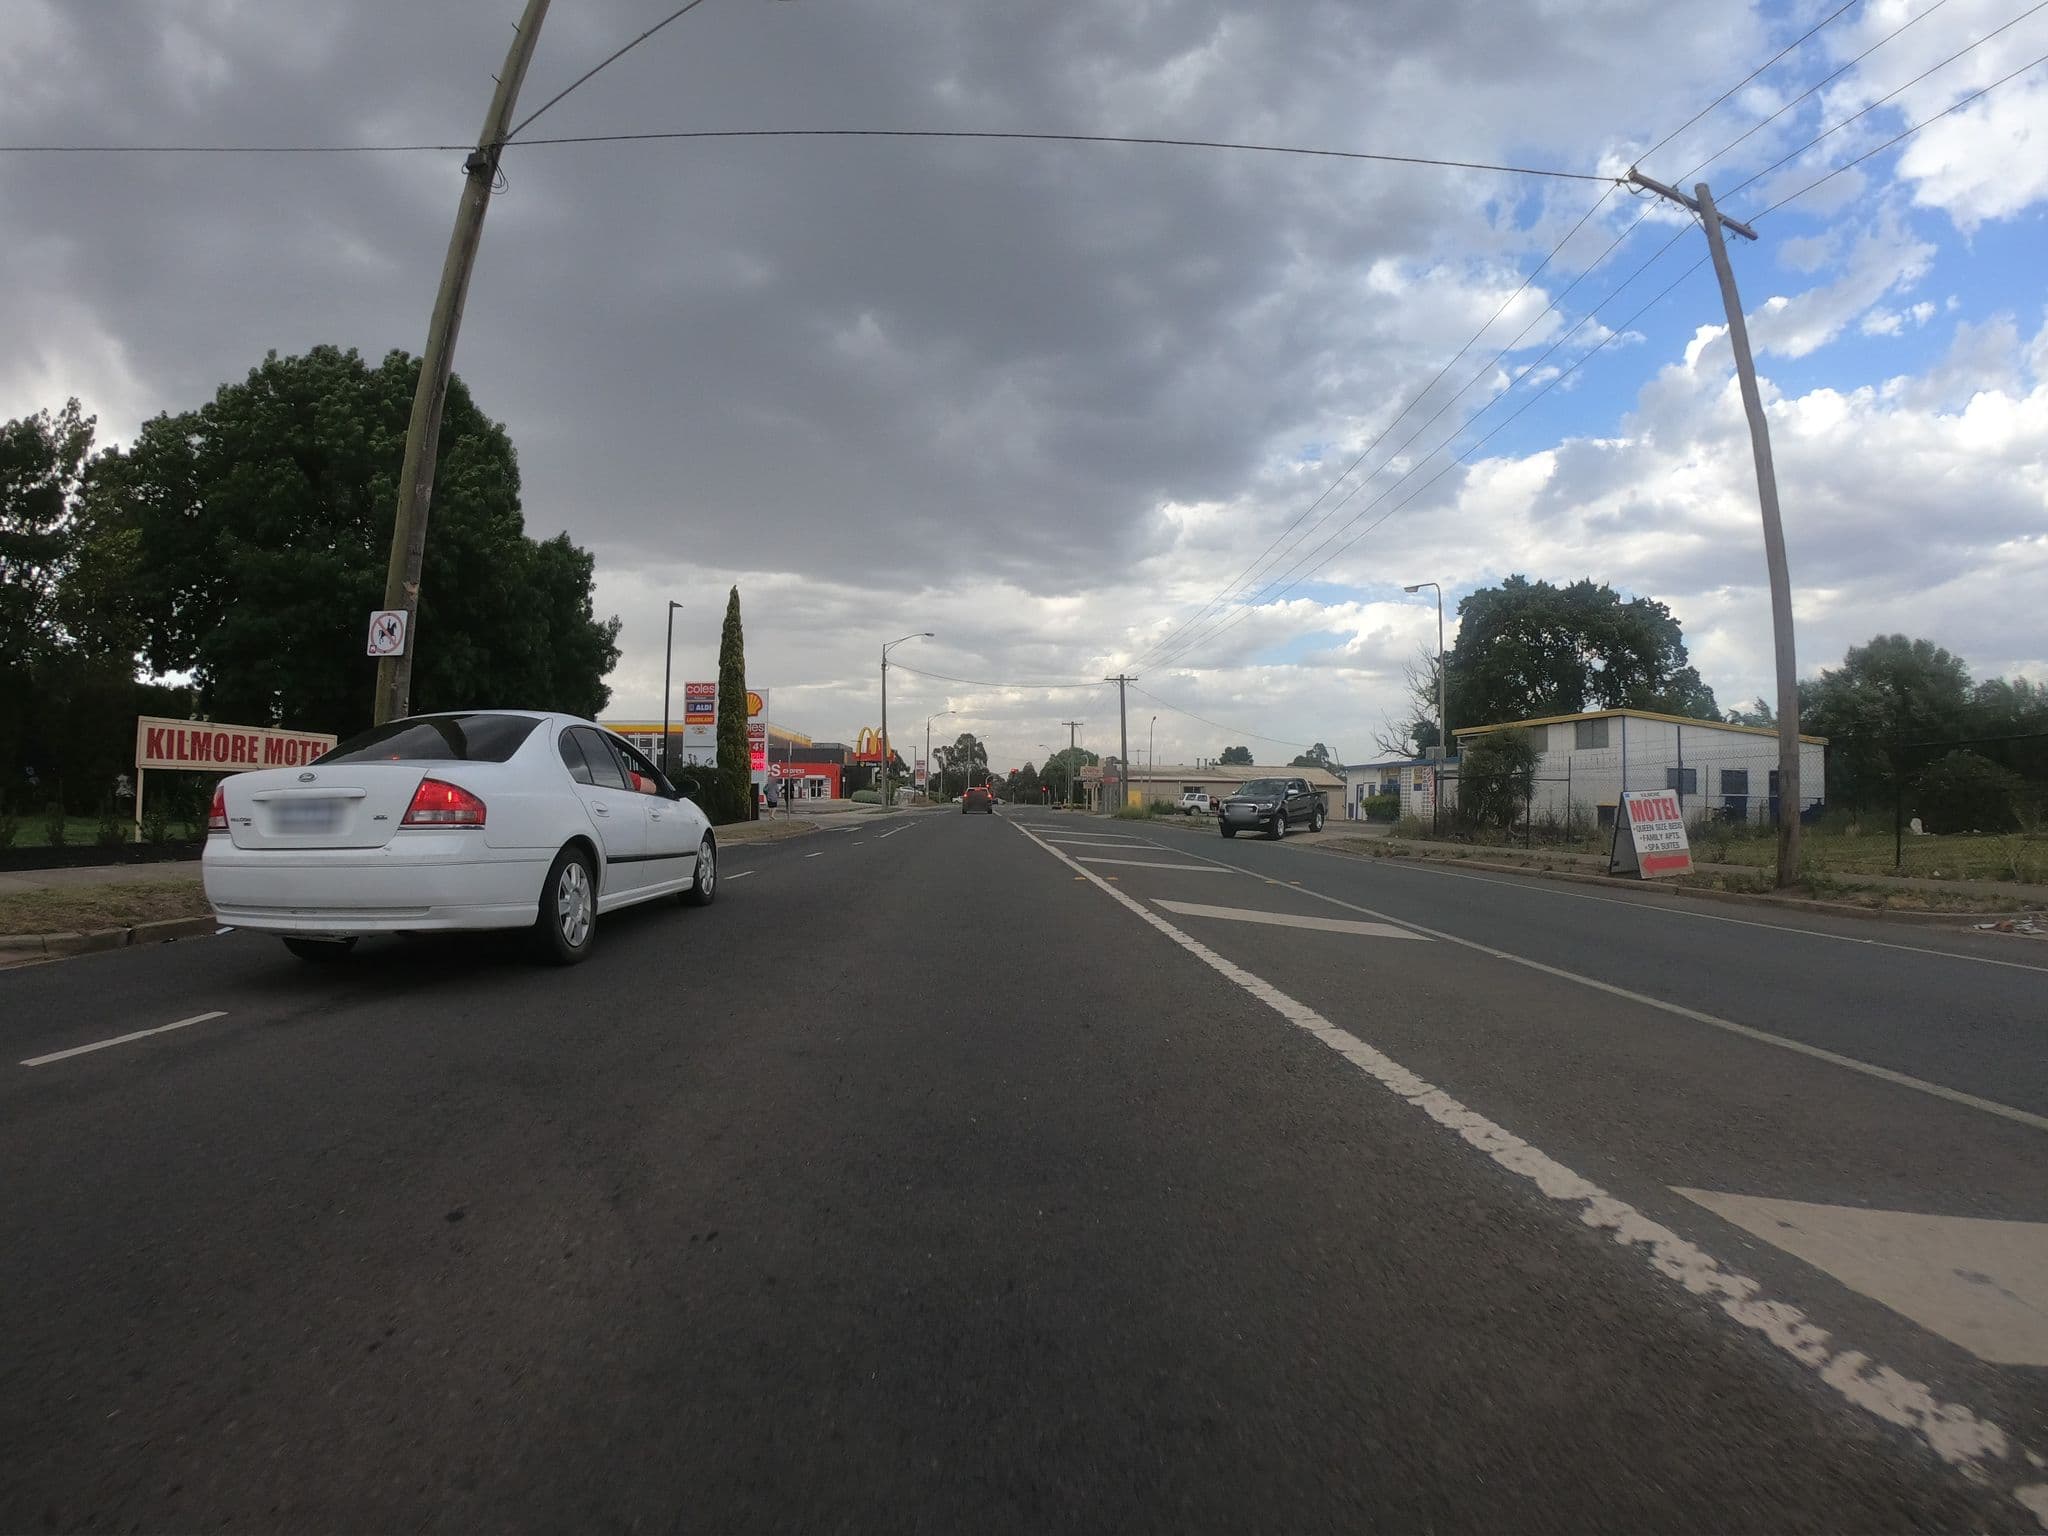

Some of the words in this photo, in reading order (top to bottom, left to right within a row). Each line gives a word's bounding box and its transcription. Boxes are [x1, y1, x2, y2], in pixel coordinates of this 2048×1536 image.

[686, 683, 715, 694] coles
[695, 703, 712, 711] ALDI
[146, 727, 258, 764] KILMORE
[1629, 798, 1679, 822] MOTEL
[1642, 833, 1663, 842] FAMILY
[1647, 843, 1660, 851] SPA
[1661, 842, 1680, 850] SUITES
